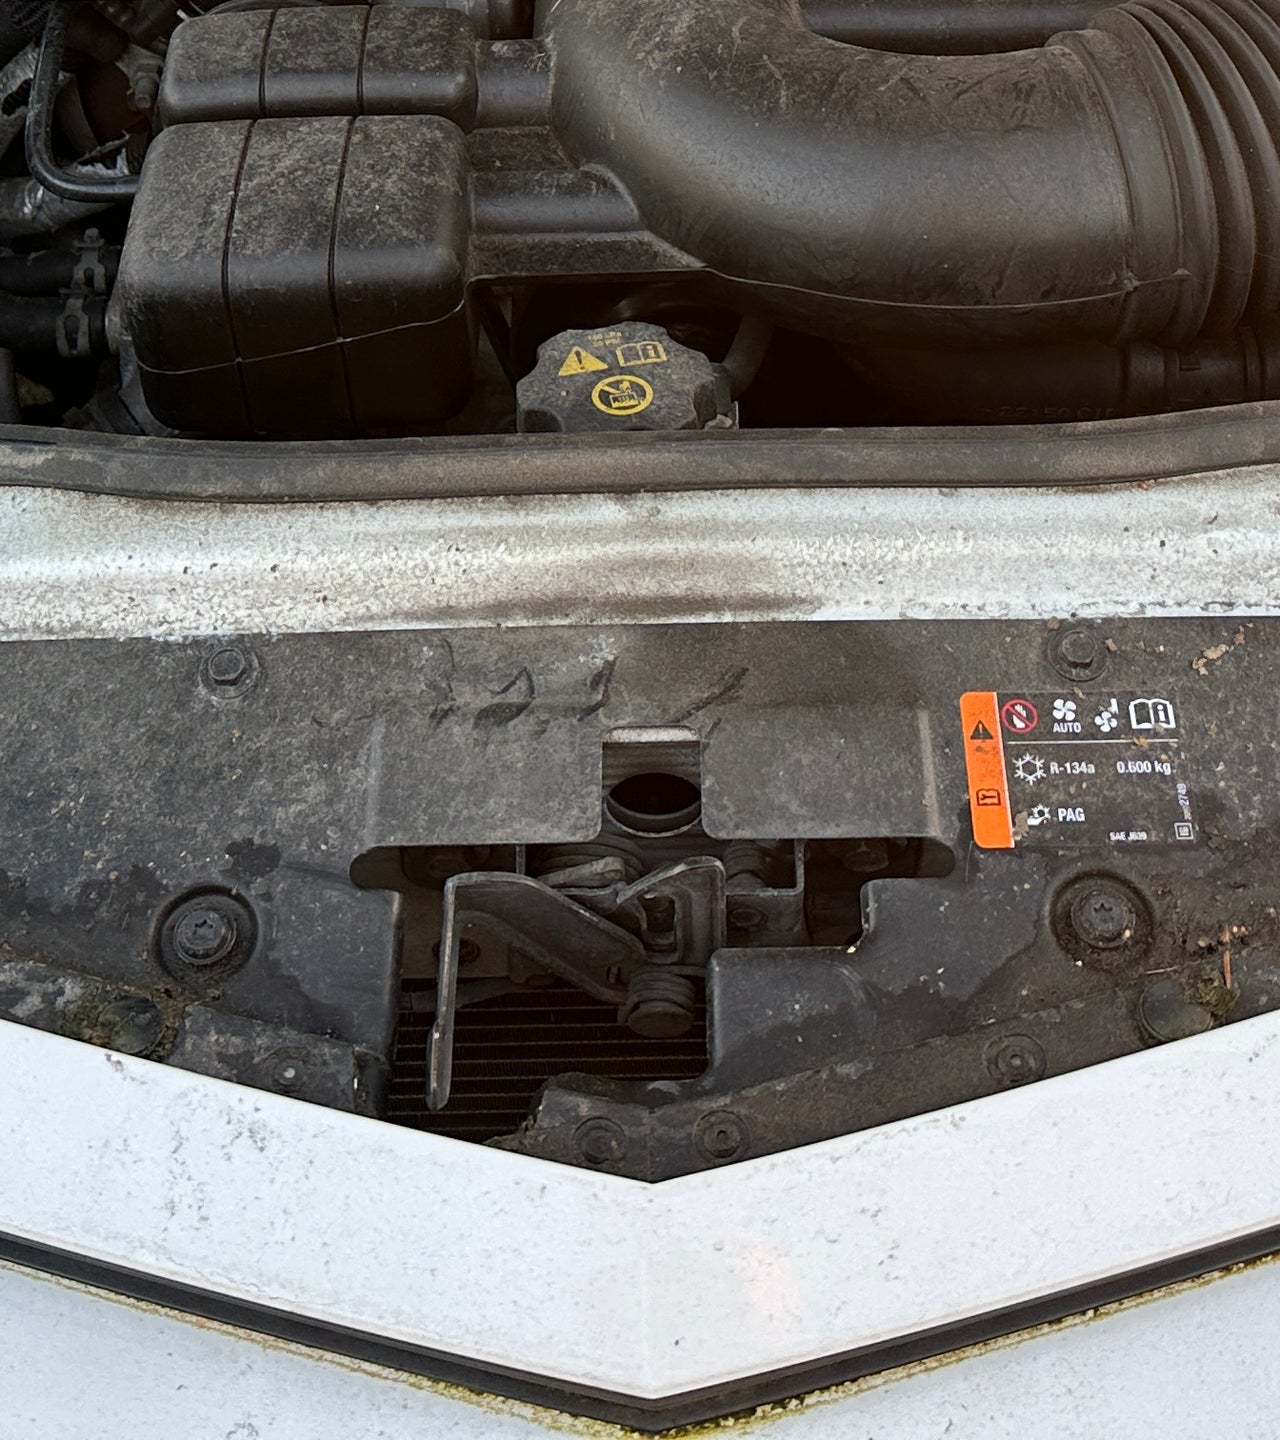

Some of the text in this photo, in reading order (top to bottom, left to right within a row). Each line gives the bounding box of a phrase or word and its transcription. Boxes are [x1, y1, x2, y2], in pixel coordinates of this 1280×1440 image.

[1053, 722, 1082, 733] AUTO
[1050, 761, 1171, 776] R-134a 0.600 kg
[1057, 807, 1086, 822] PAG
